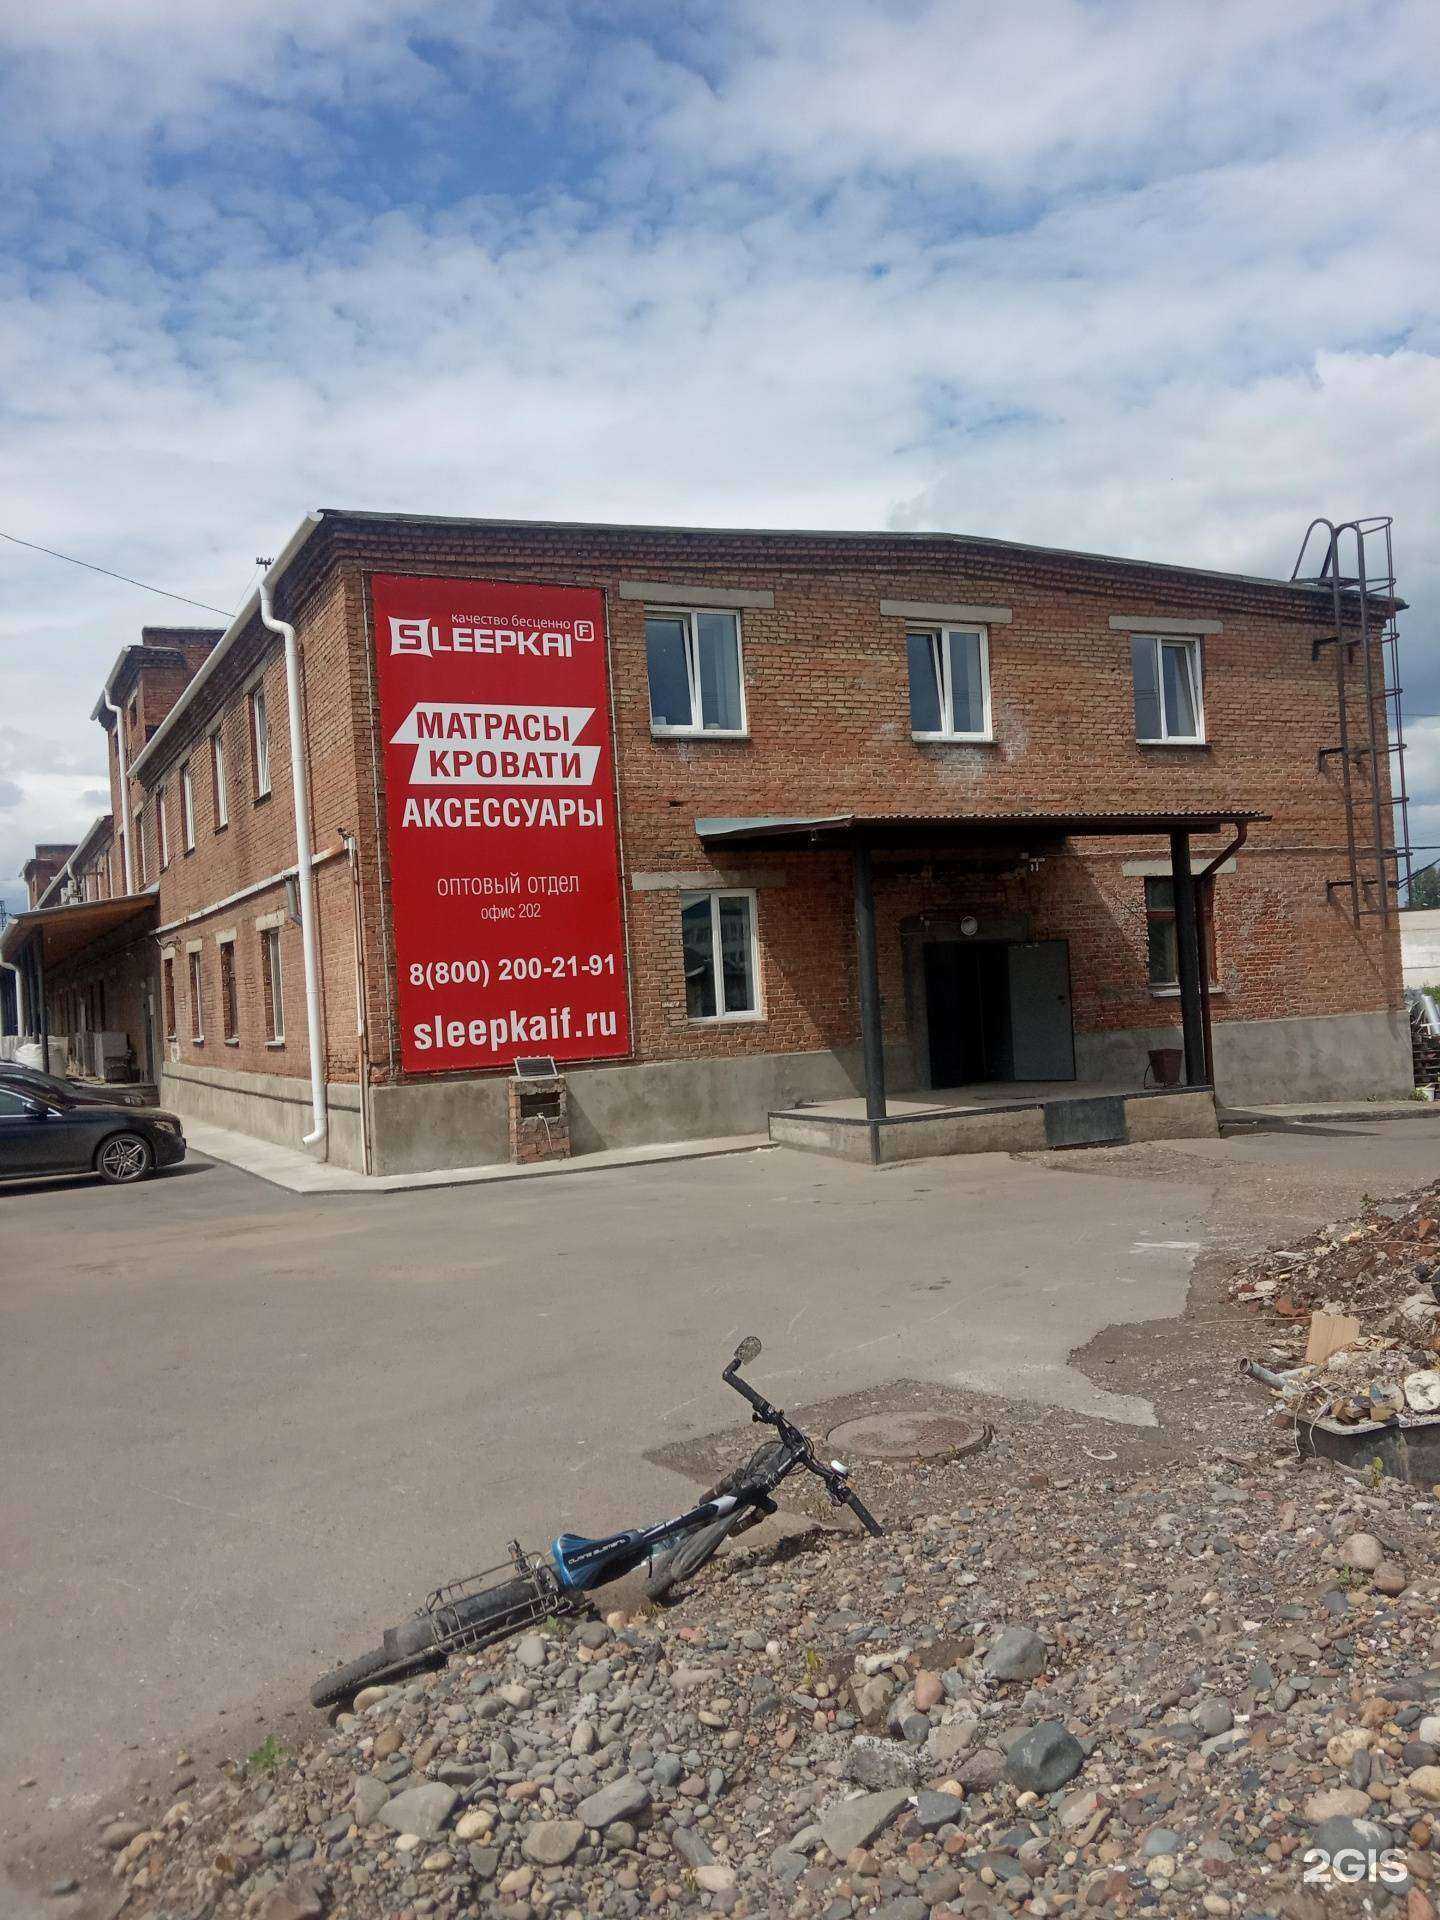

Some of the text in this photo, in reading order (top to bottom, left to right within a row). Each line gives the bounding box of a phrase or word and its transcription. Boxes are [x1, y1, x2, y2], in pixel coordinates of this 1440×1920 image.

[511, 615, 571, 630] бесценно
[416, 711, 570, 742] МАТРАСЫ
[429, 750, 581, 779] КРОВАТИ
[402, 798, 603, 828] АКСЕССУАРЫ
[437, 872, 580, 896] оптовый отдел
[481, 903, 541, 922] офис 202
[409, 953, 615, 991] 8(800) 200-21-91
[413, 1007, 617, 1051] sleepkaif.ru
